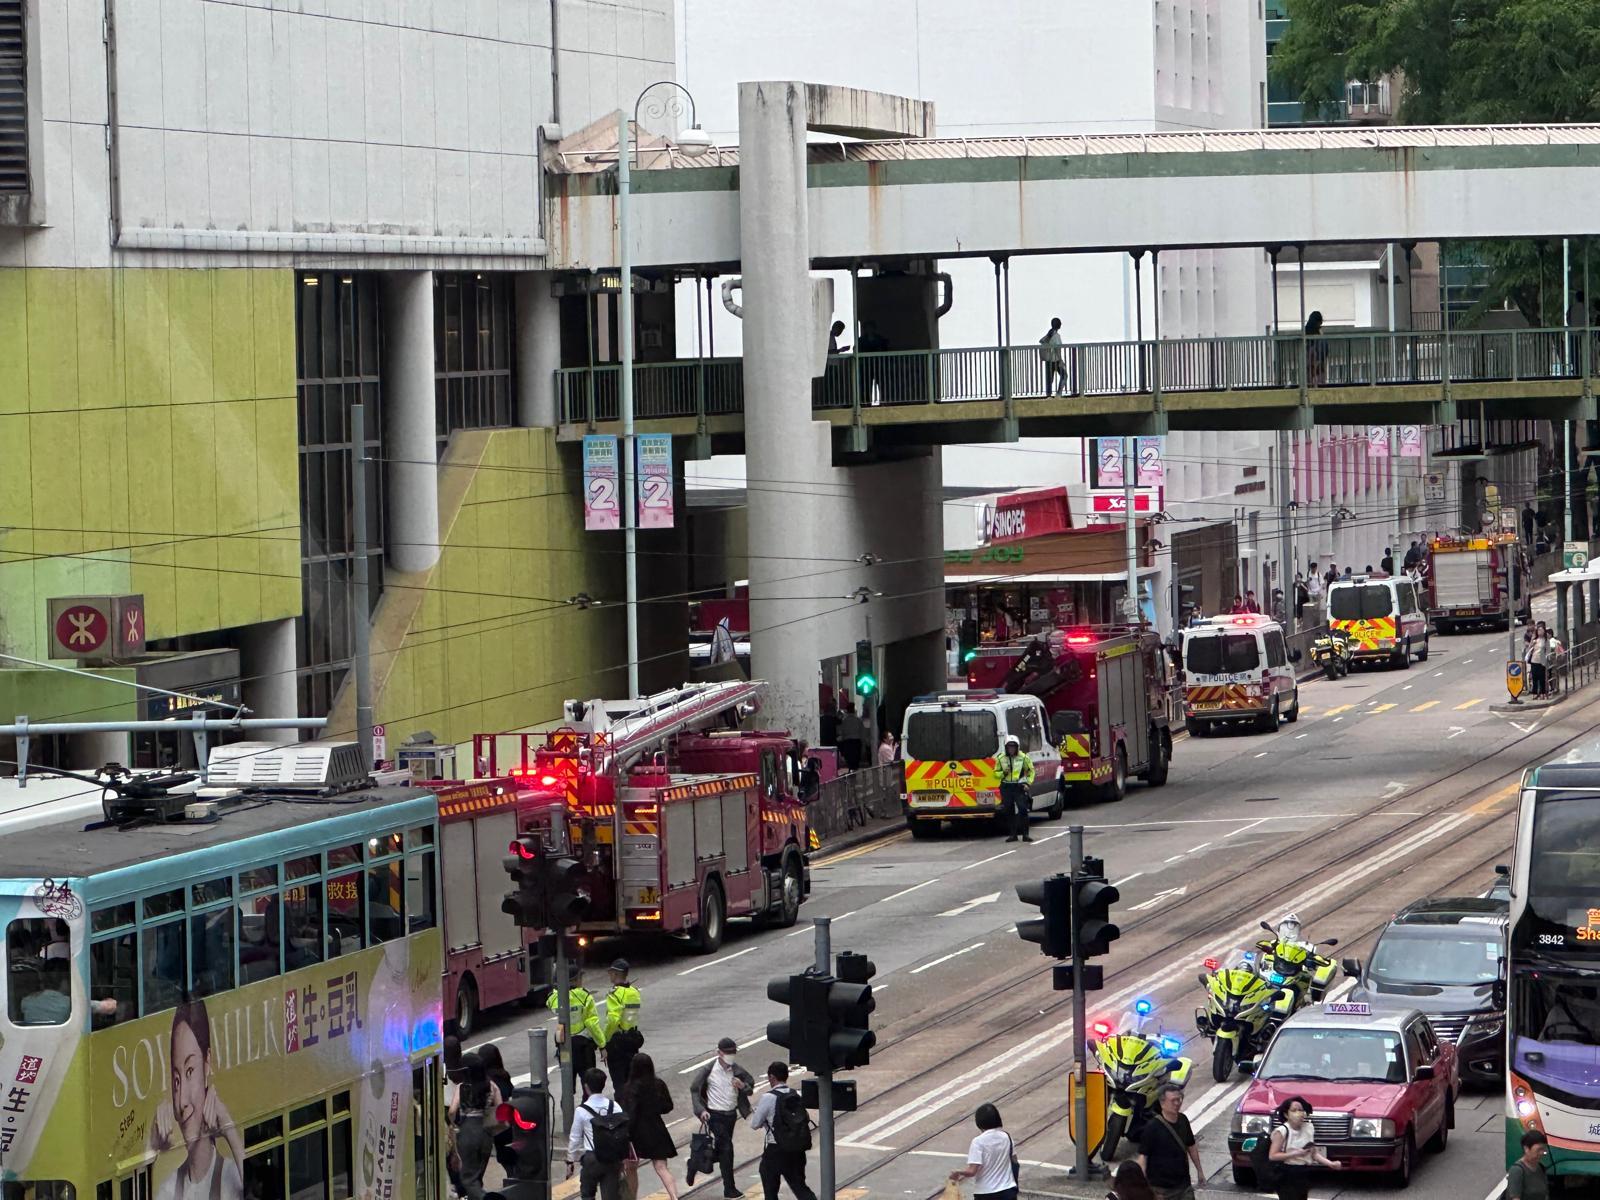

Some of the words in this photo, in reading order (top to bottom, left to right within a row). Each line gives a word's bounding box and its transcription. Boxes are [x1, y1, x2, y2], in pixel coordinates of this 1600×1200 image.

[1371, 425, 1385, 446] 2
[1403, 425, 1418, 446] 2
[1102, 448, 1120, 473] 2
[1141, 447, 1160, 471] 2
[589, 477, 615, 510] 2
[643, 475, 669, 508] 2
[994, 508, 1026, 538] SINOPEC
[1208, 673, 1239, 682] POLICE
[934, 777, 972, 789] POLICE
[1539, 934, 1564, 945] 3842
[1329, 1003, 1367, 1013] TAXI
